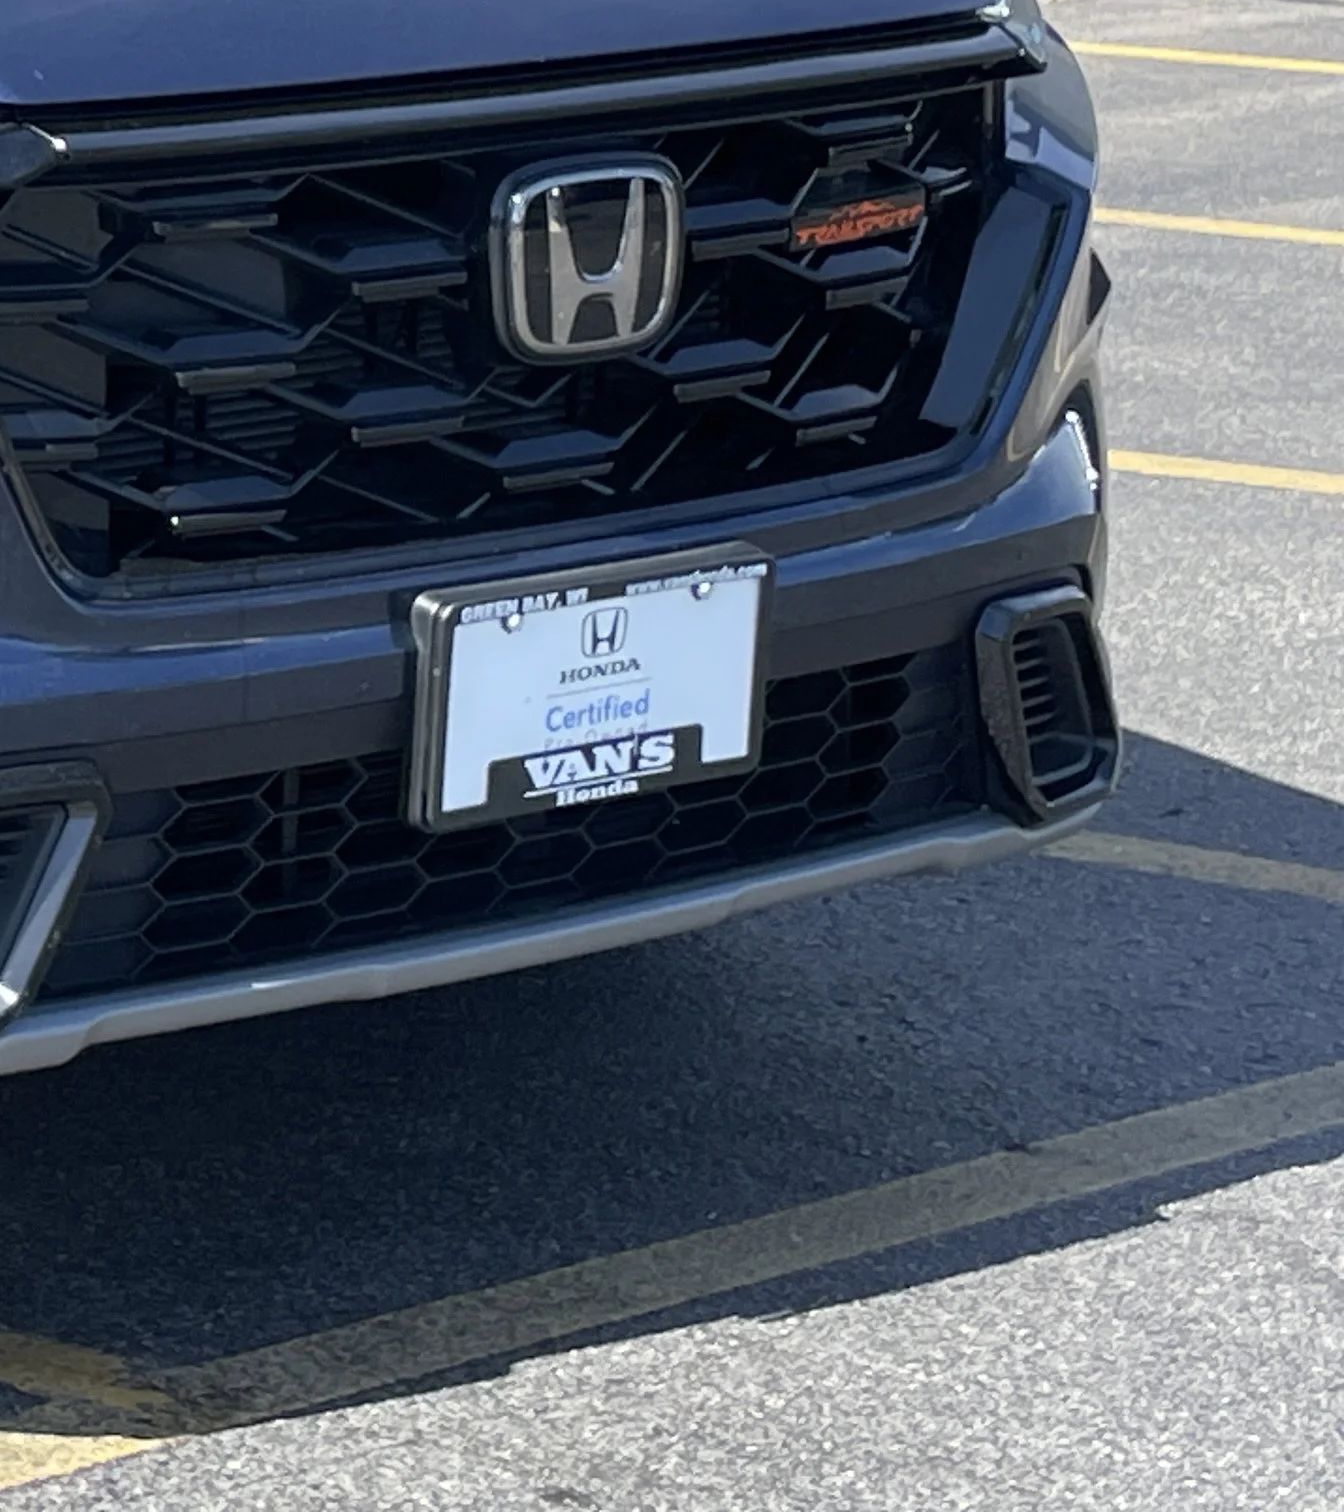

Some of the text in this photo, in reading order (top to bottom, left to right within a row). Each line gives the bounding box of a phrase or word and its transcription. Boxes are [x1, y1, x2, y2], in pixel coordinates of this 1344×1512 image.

[461, 597, 519, 624] GREEN
[559, 657, 641, 684] HONDA
[545, 688, 650, 732] Certified
[556, 780, 639, 807] Honda
